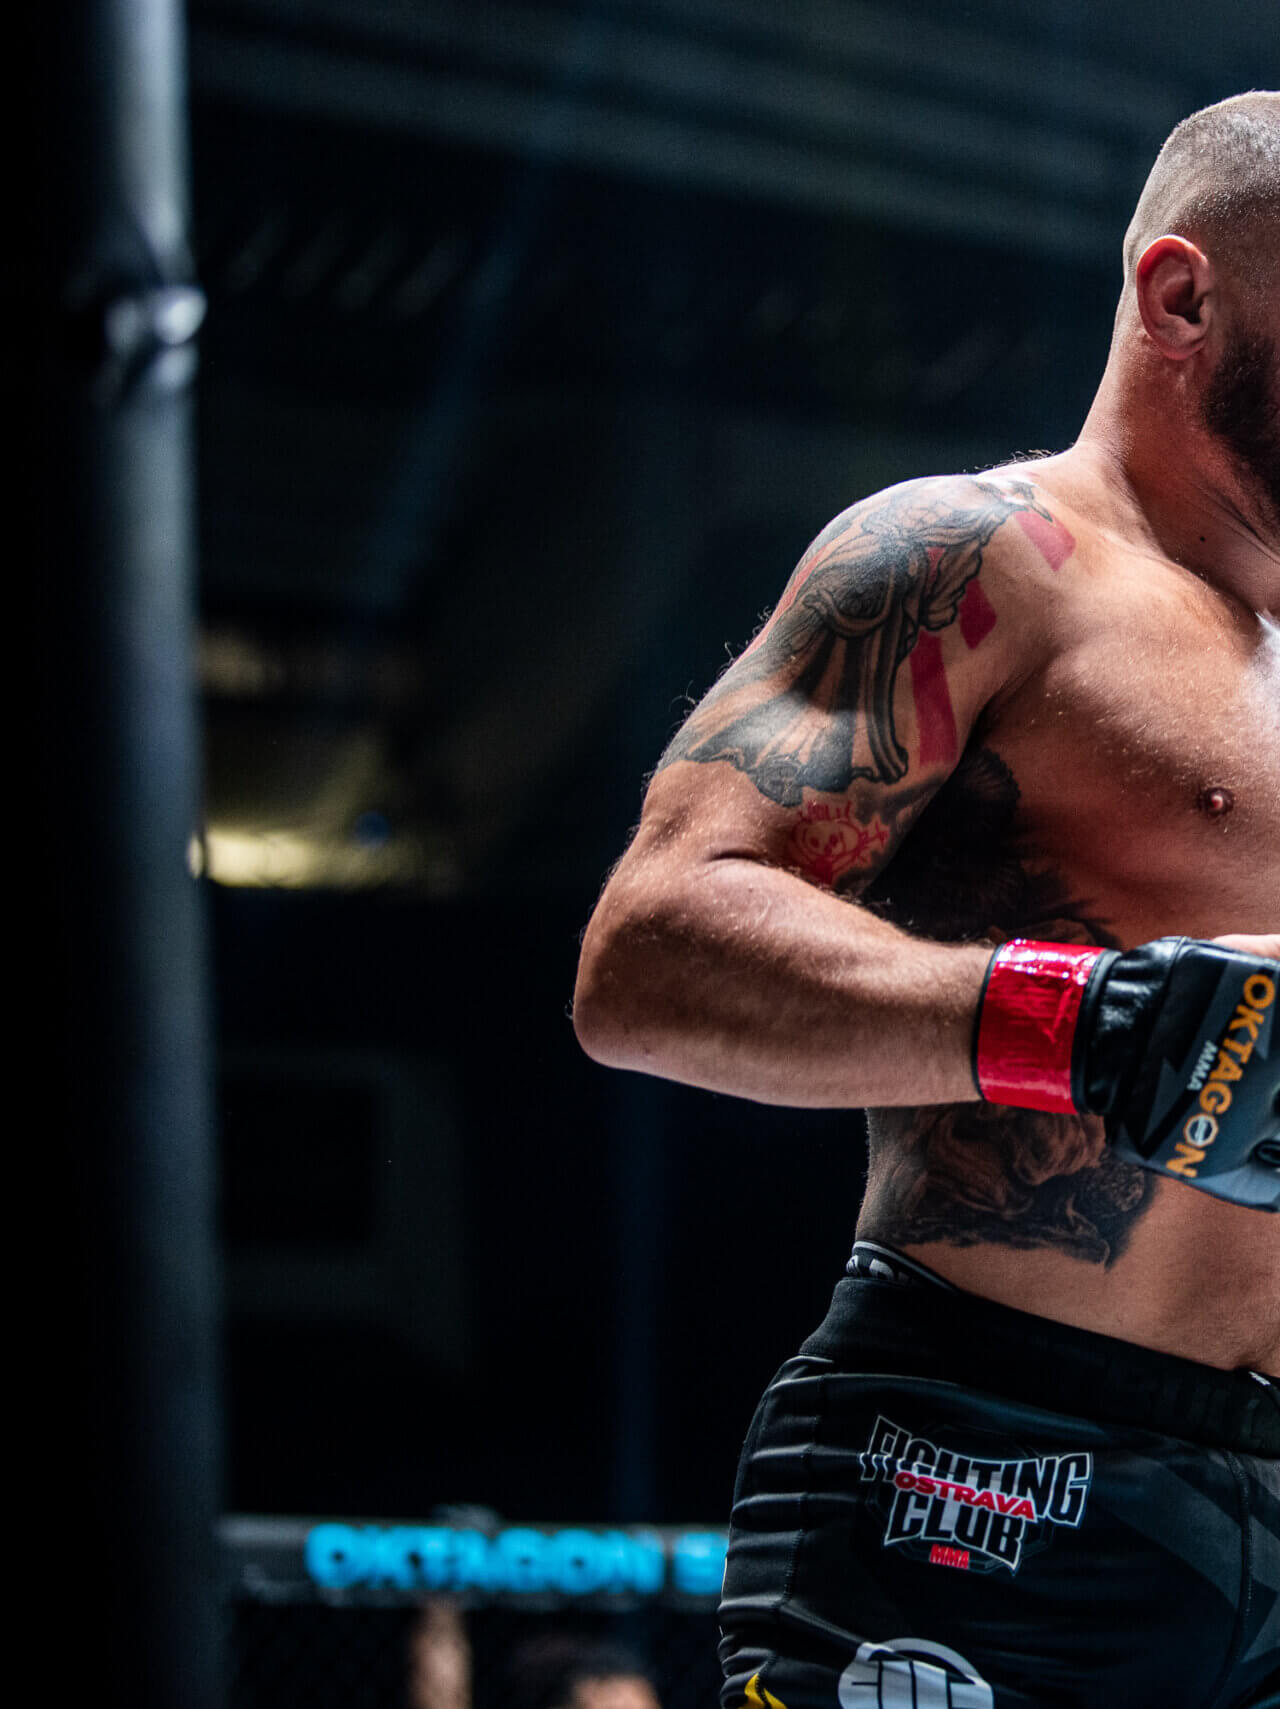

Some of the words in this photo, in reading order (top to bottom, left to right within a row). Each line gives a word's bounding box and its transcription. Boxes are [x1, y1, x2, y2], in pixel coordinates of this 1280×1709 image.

[1166, 973, 1276, 1178] OKTAGON
[1186, 1040, 1219, 1092] MMA
[857, 1413, 1093, 1528] FIGHTING
[894, 1472, 1038, 1523] OSTRAVA
[883, 1490, 1027, 1571] CLUB
[929, 1543, 970, 1570] MMA
